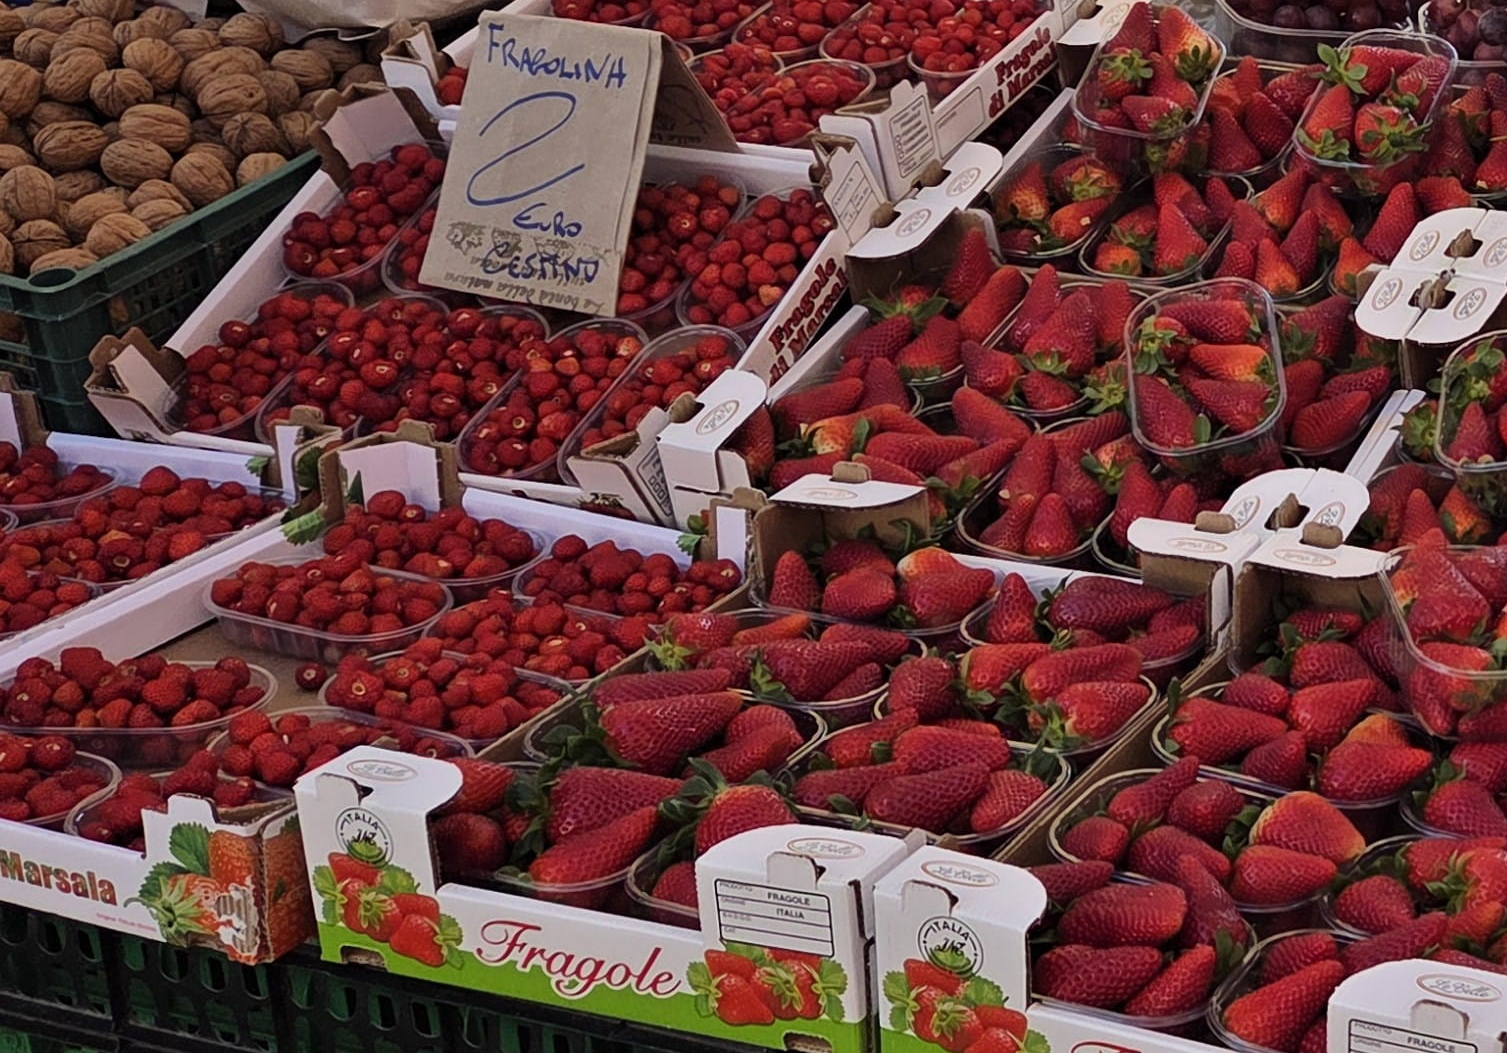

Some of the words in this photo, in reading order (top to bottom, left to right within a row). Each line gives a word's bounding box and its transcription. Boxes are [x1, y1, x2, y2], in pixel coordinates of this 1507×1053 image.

[1007, 40, 1058, 103] Marsal
[466, 90, 585, 207] 2
[768, 257, 837, 356] Fragole
[788, 265, 849, 364] Marsal
[345, 812, 379, 830] ITALIA
[0, 848, 118, 907] Marsala
[767, 891, 811, 906] FRAGOLE
[776, 908, 805, 920] ITALIA
[930, 920, 970, 941] ITALIA
[476, 921, 682, 997] Fragole
[1407, 1036, 1456, 1053] FRAGOLE
